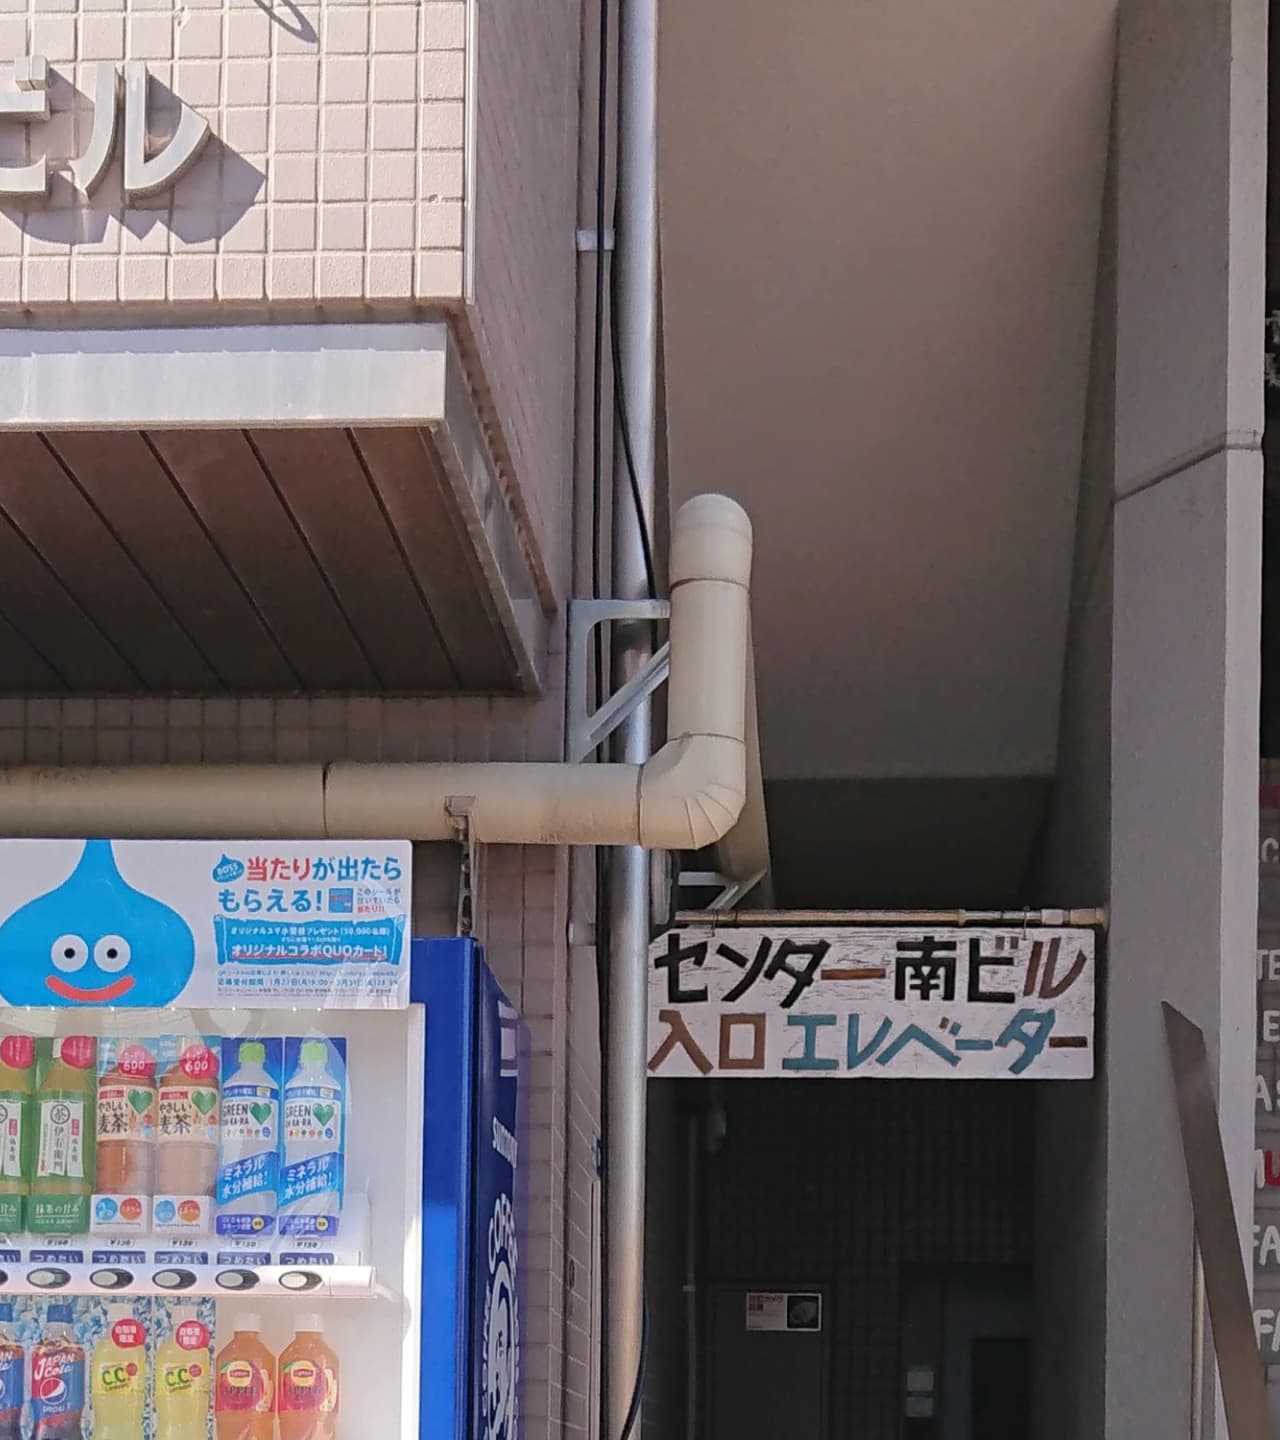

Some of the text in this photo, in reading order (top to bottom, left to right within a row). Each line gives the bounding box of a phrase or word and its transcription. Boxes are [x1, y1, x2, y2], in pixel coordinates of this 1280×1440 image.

[246, 856, 402, 882] 当たりが出たら
[218, 888, 323, 913] もらえる!
[654, 933, 1087, 1008] センター南ビル
[648, 1008, 1087, 1074] 入口 エレベーター
[123, 1059, 145, 1071] 600
[185, 1060, 207, 1072] 600
[97, 1114, 128, 1135] 麦茶
[159, 1115, 192, 1135] 麦茶
[223, 1157, 264, 1182] ミネラル
[286, 1157, 329, 1183] ミネラル
[34, 1352, 76, 1381] JAPAN
